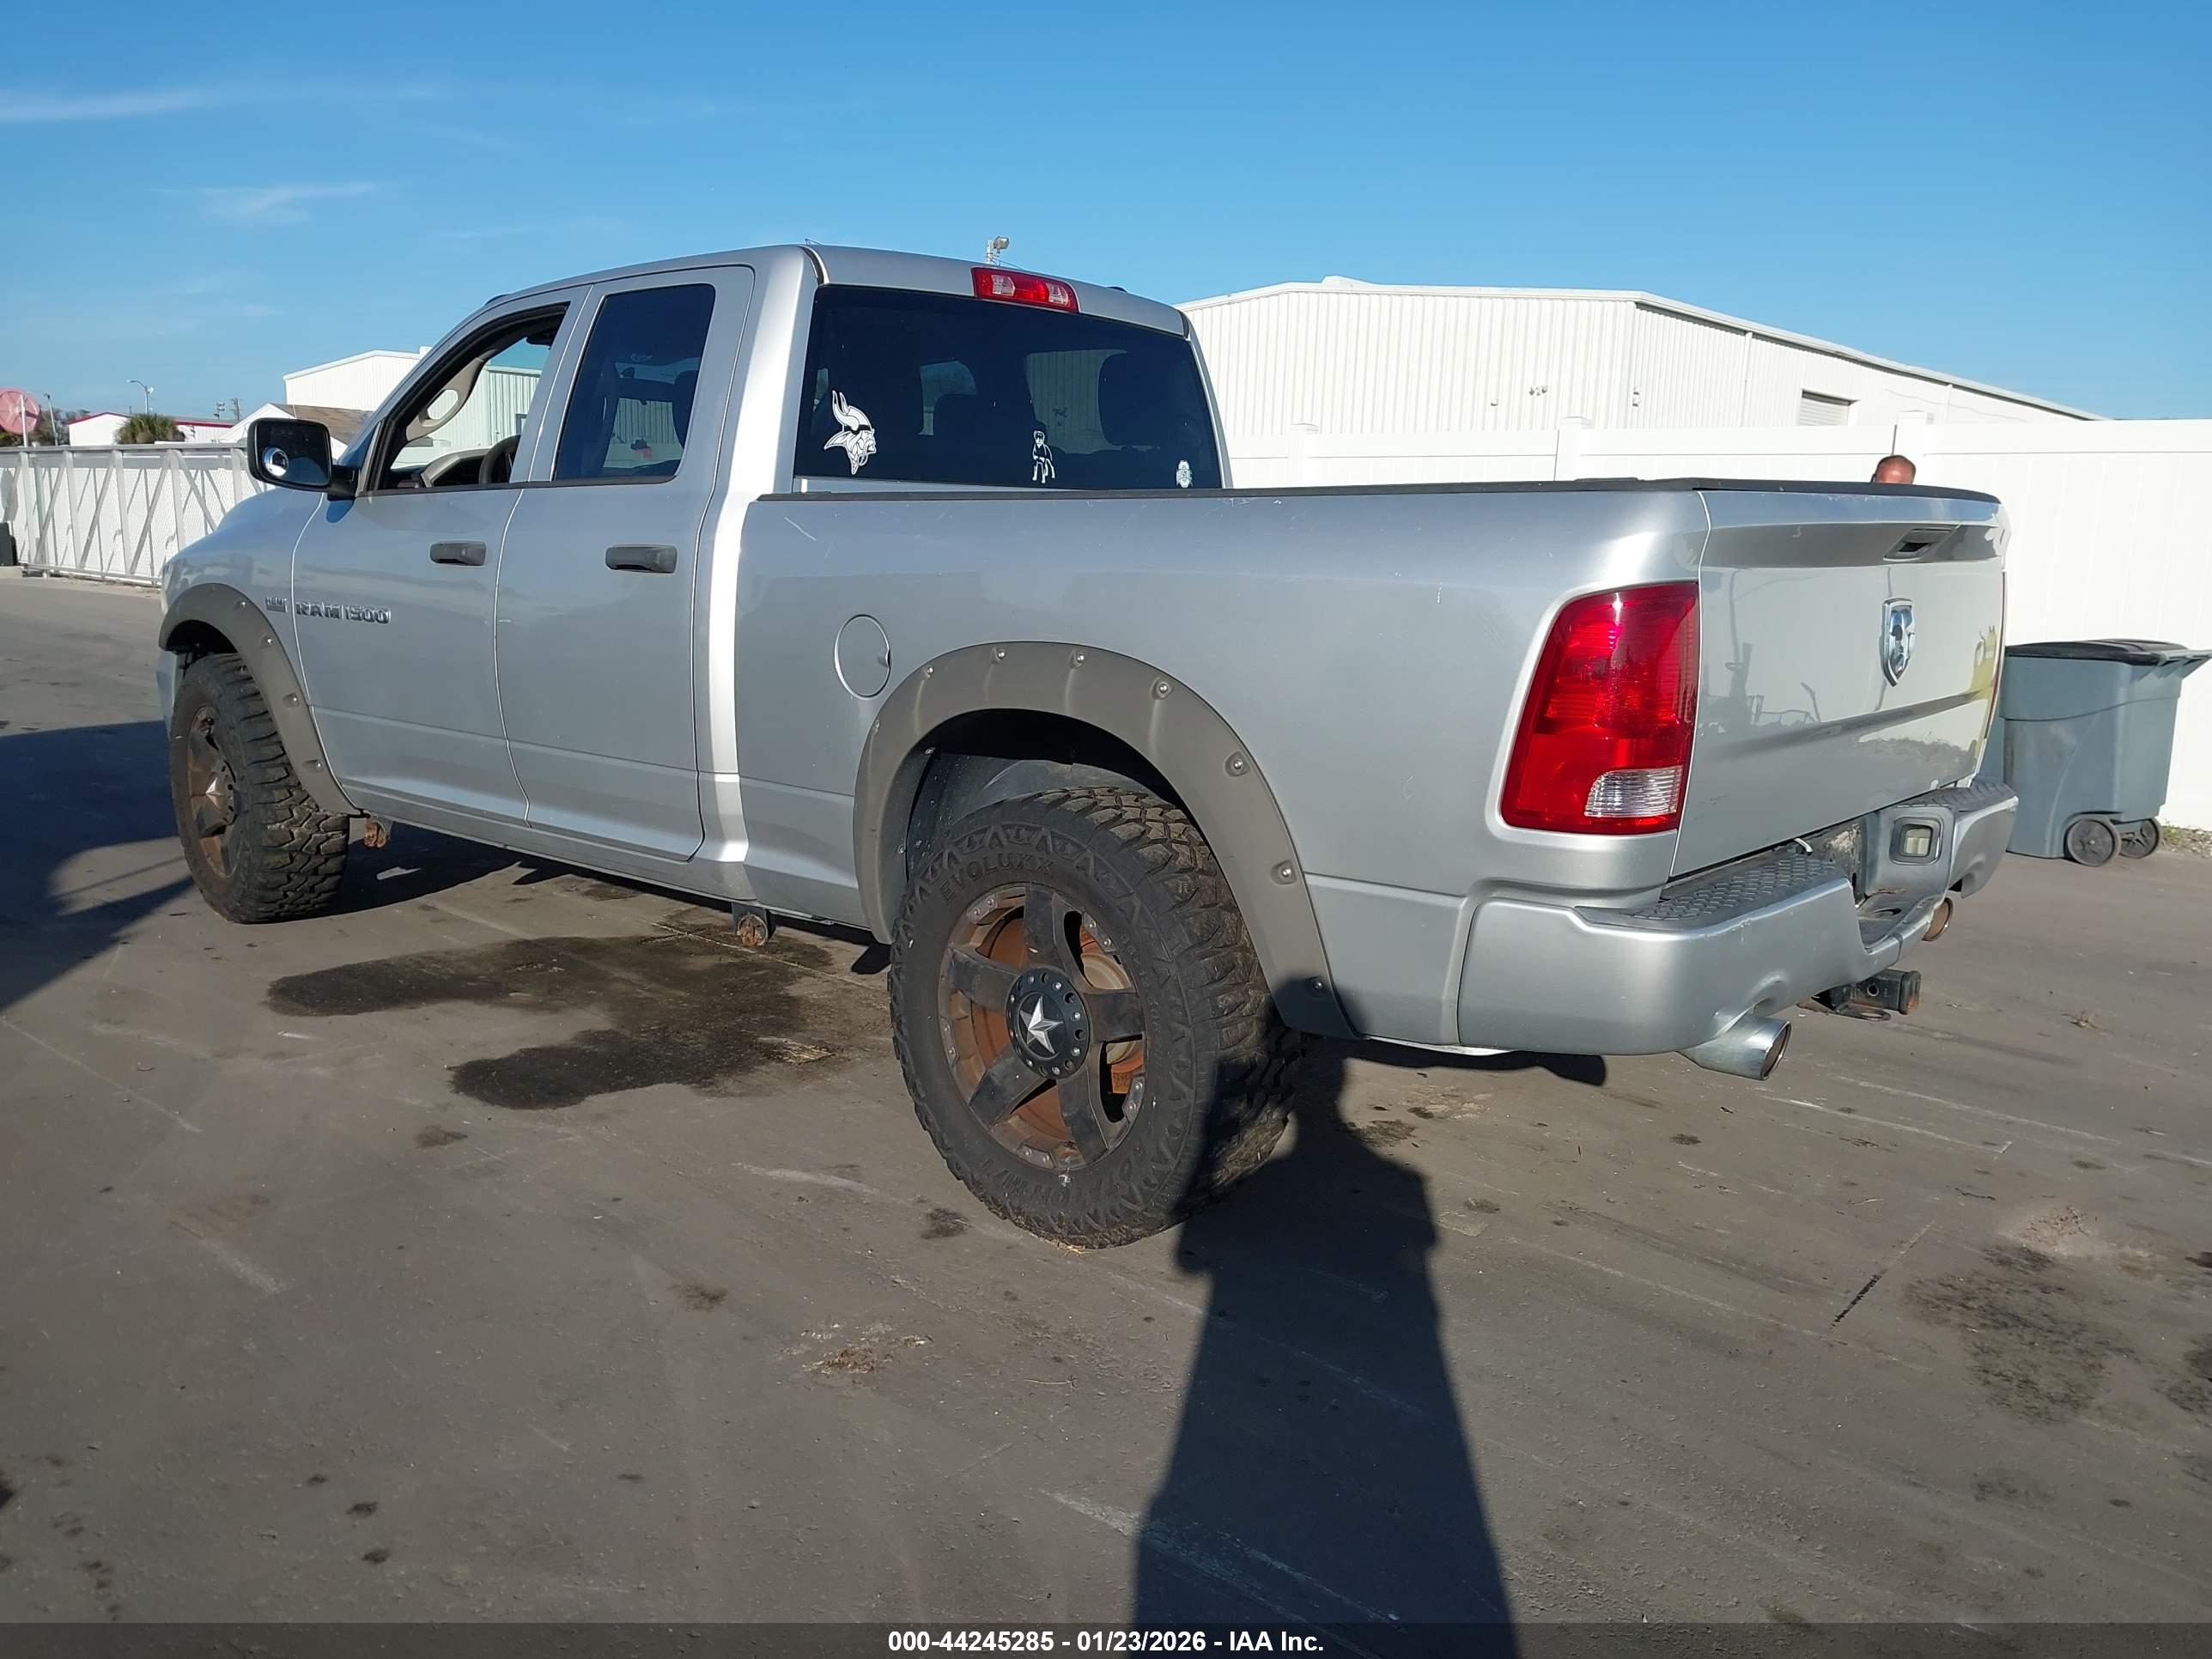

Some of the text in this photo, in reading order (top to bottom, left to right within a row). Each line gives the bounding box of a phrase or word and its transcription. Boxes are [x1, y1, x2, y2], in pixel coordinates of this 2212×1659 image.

[295, 602, 391, 625] RAM 1500
[939, 854, 1054, 901] EVOLUXX
